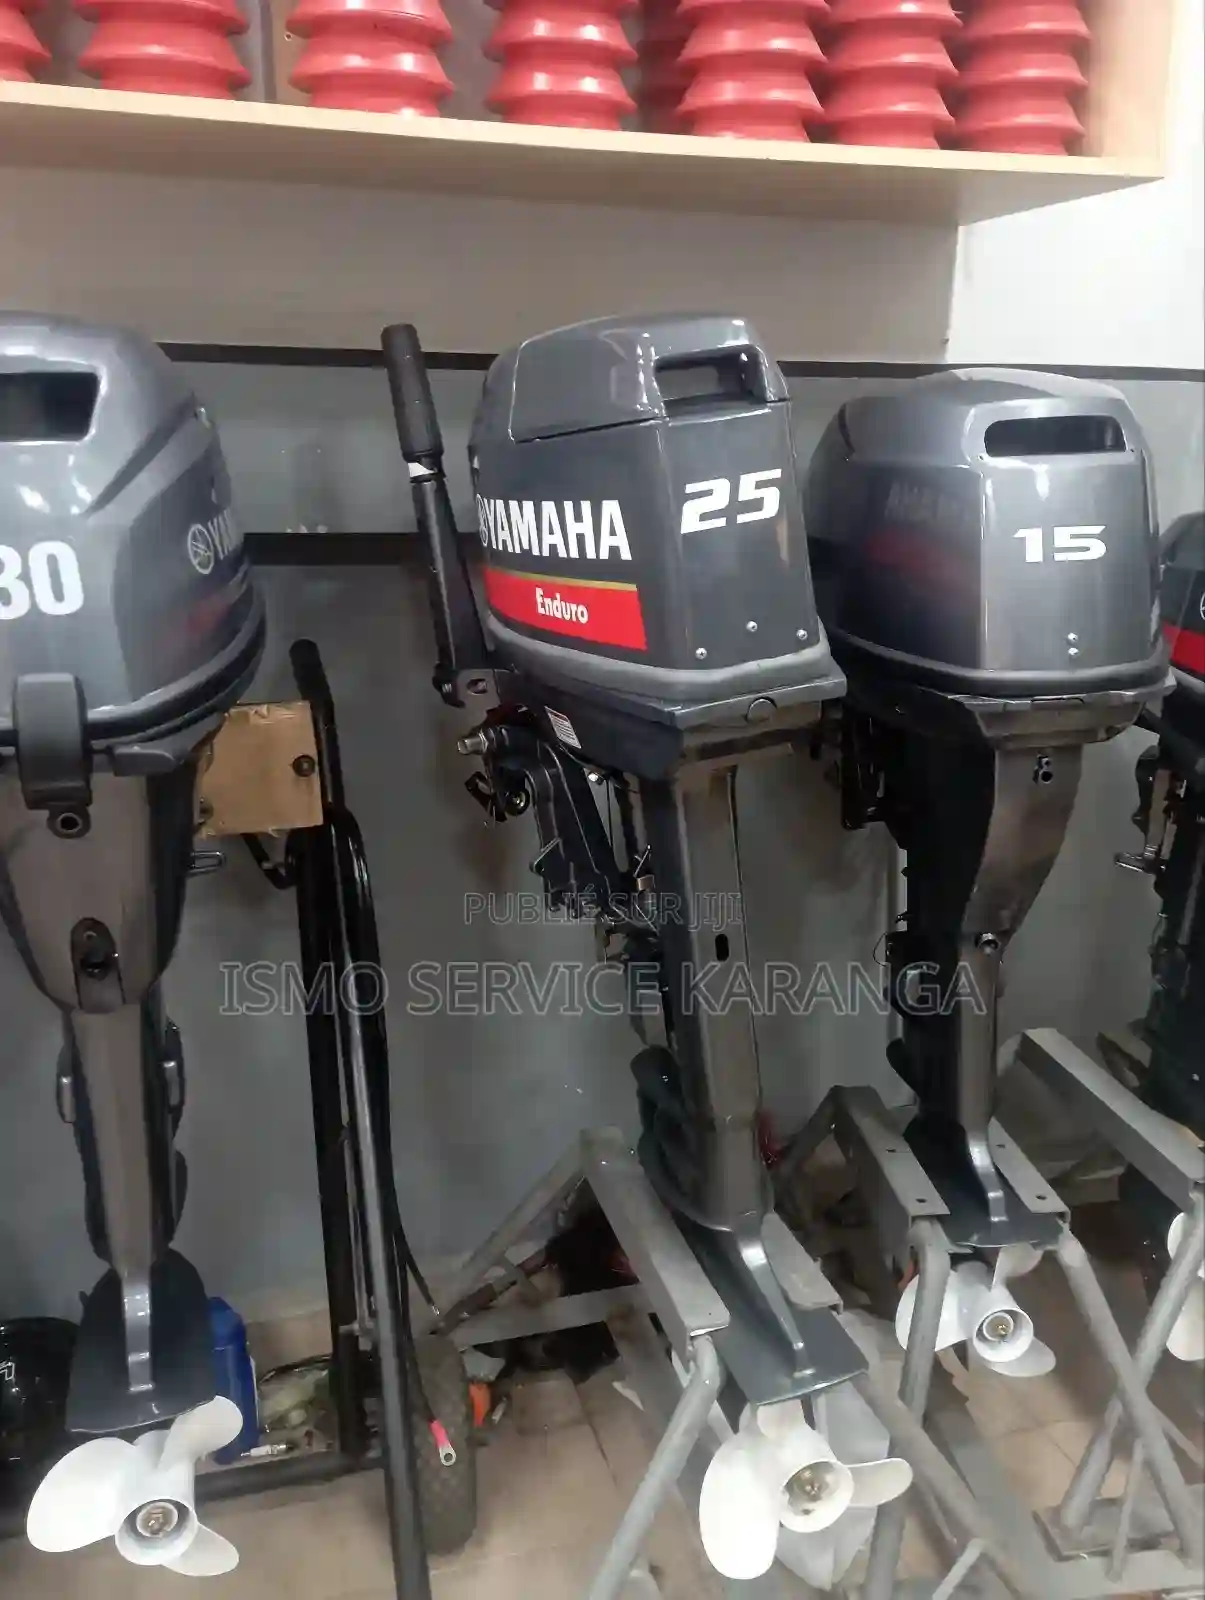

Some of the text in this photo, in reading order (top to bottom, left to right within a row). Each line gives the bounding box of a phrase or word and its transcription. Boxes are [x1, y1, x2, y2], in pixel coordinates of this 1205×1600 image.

[681, 468, 782, 534] 25
[484, 498, 633, 561] YAMAHA
[1012, 525, 1107, 563] 15
[535, 587, 589, 624] Enduro
